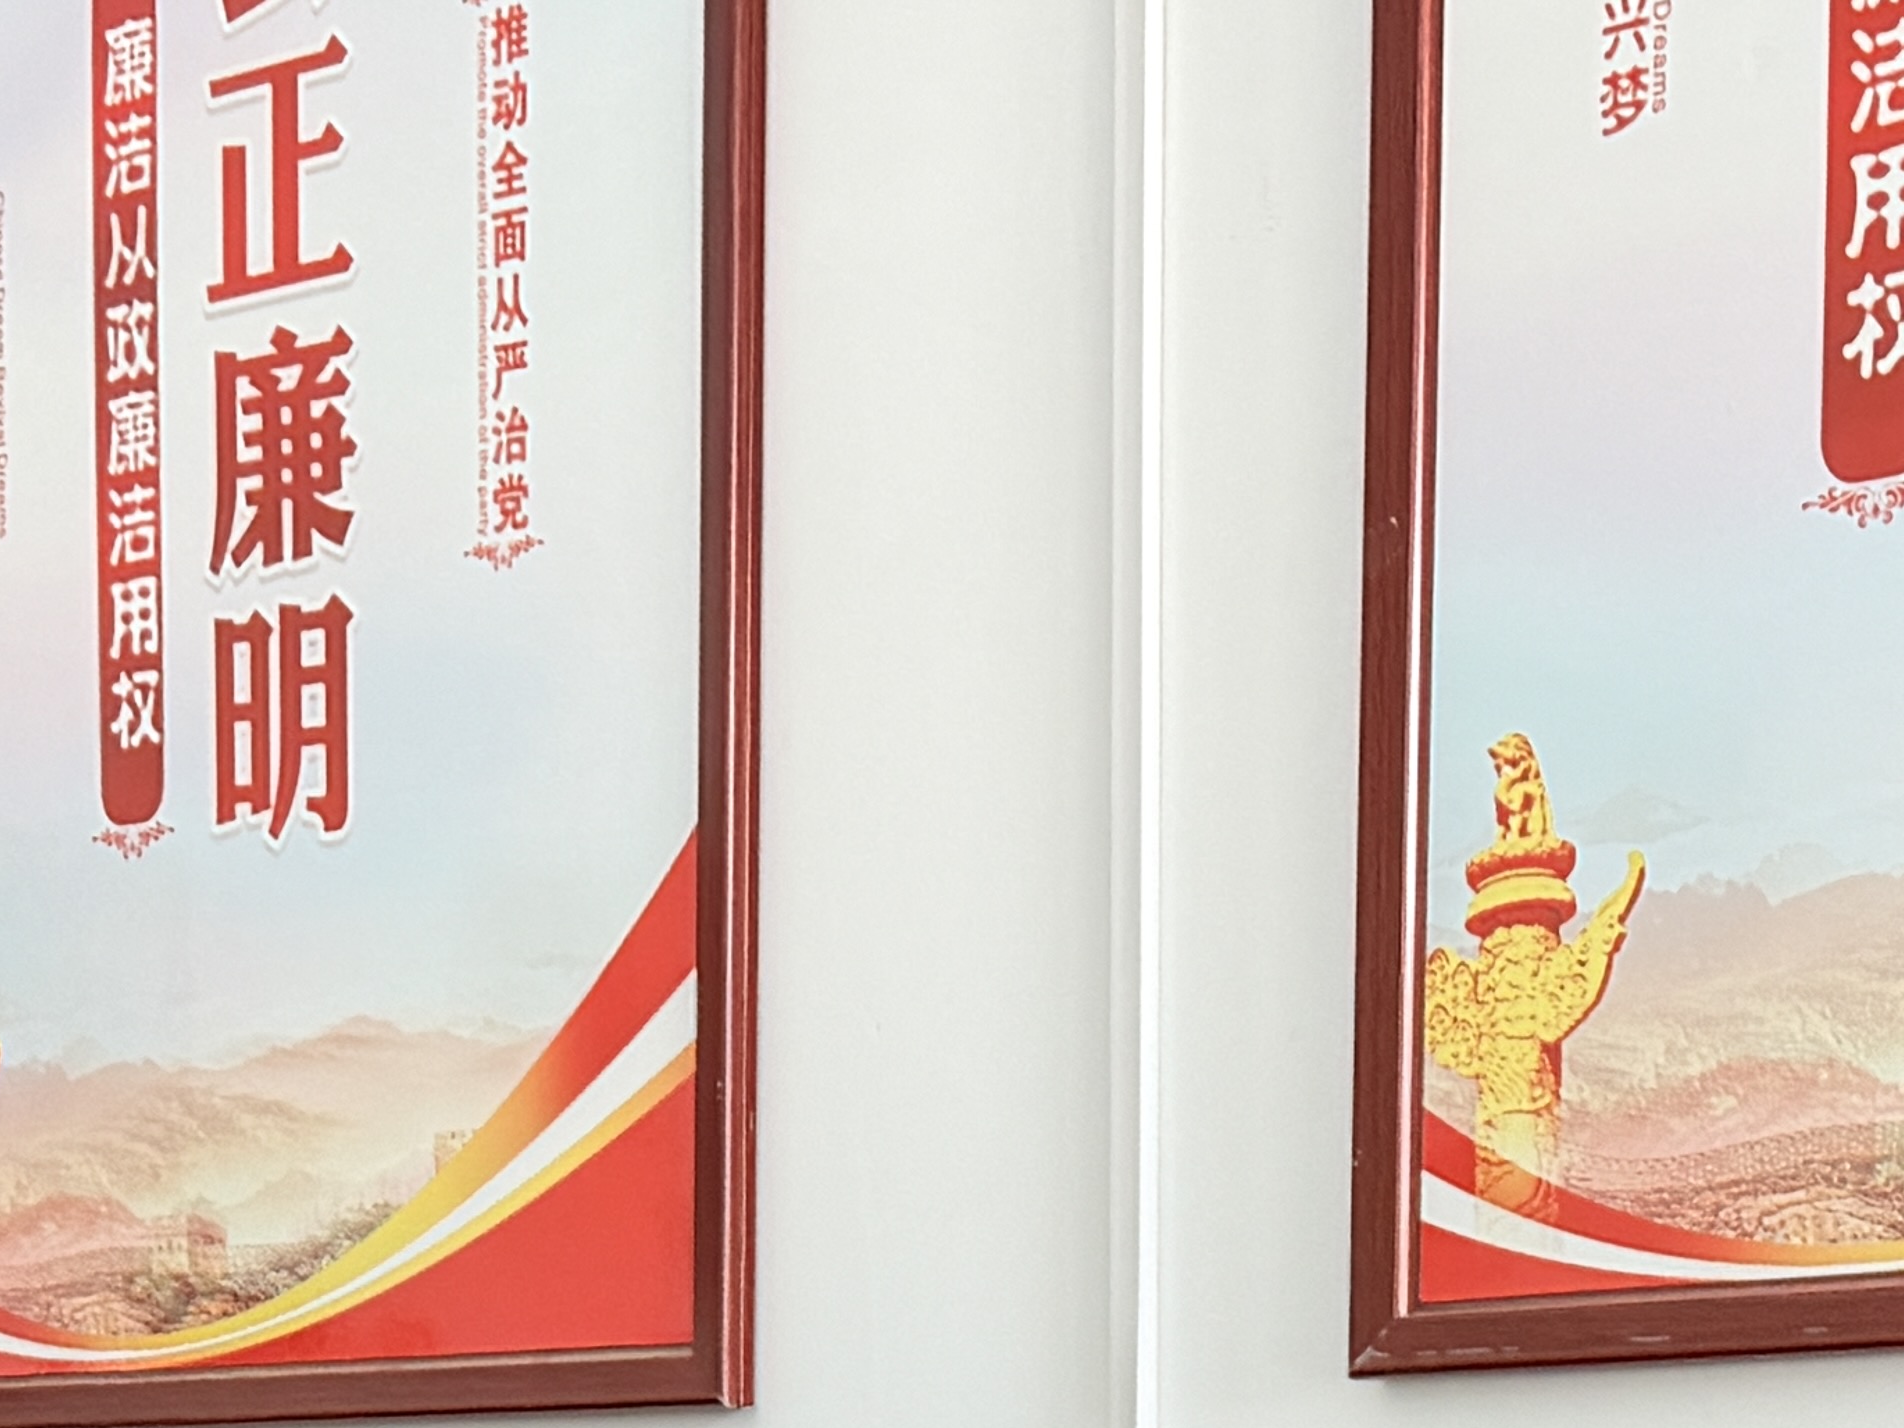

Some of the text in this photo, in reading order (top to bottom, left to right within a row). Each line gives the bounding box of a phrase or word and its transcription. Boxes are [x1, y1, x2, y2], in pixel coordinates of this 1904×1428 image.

[104, 17, 161, 750] 廉洁从政廉洁用权
[206, 0, 356, 840] 正廉明
[491, 3, 529, 534] 推动全面从严治党
